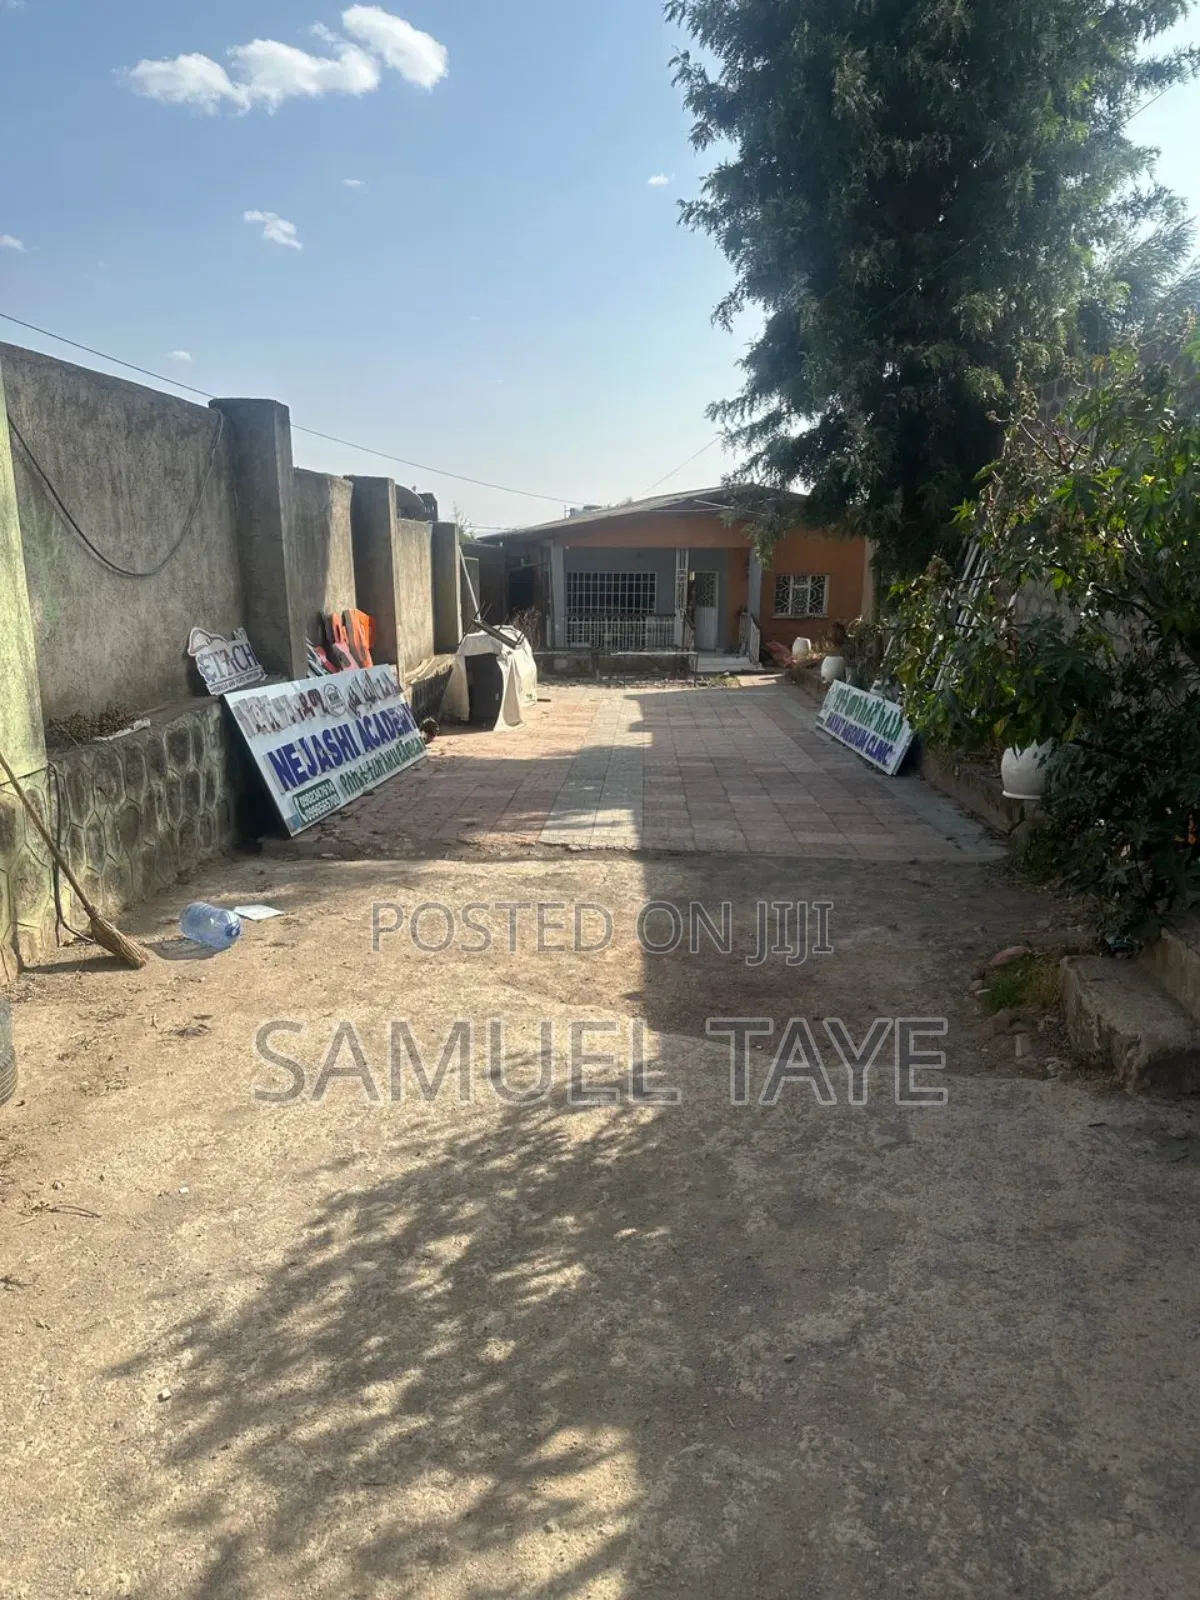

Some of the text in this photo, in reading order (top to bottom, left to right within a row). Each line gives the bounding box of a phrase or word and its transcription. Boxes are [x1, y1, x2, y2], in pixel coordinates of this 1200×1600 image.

[267, 724, 361, 791] NEJASHI
[355, 702, 418, 752] ACADEMY
[865, 734, 893, 765] CLINIC
